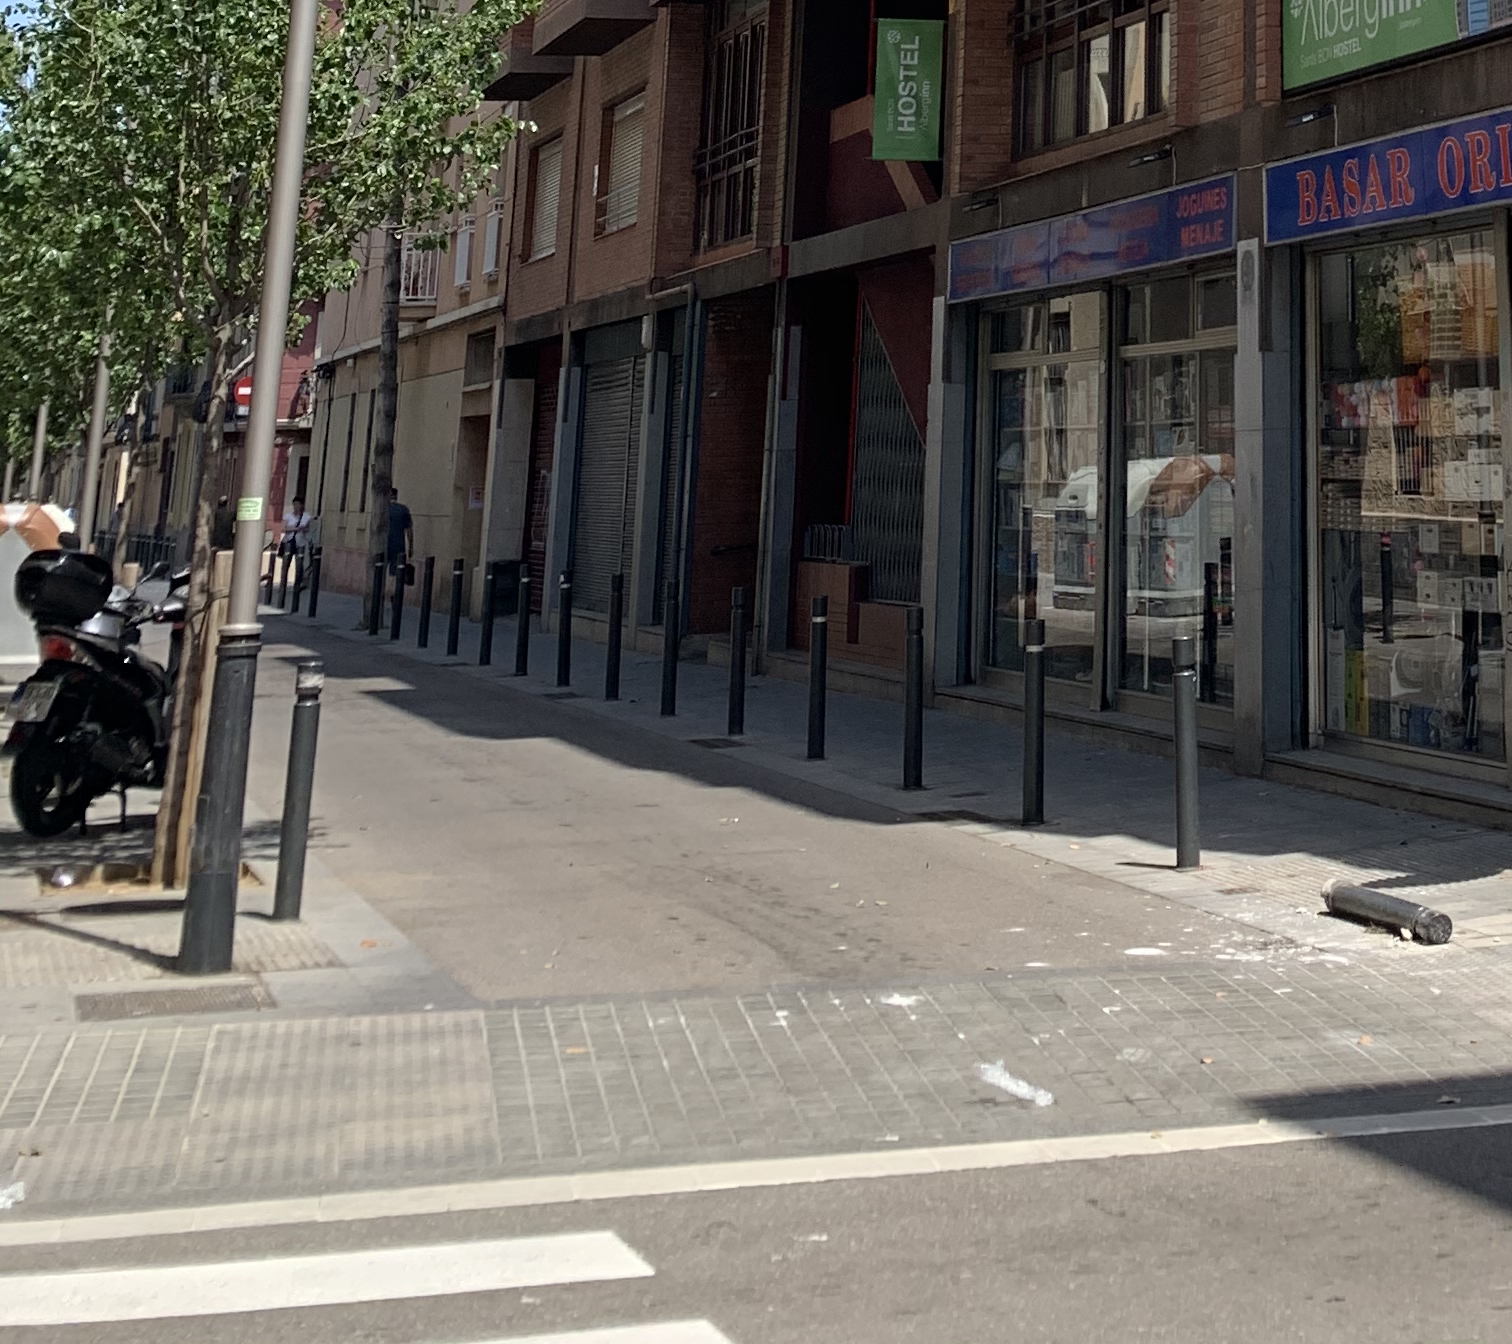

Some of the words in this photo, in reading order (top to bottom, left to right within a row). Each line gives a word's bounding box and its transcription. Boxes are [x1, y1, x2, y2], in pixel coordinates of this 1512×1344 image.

[1333, 38, 1362, 59] HOSTEL
[897, 35, 920, 132] HOSTEL
[1296, 147, 1415, 226] BASAR
[1180, 218, 1225, 249] MENAJE
